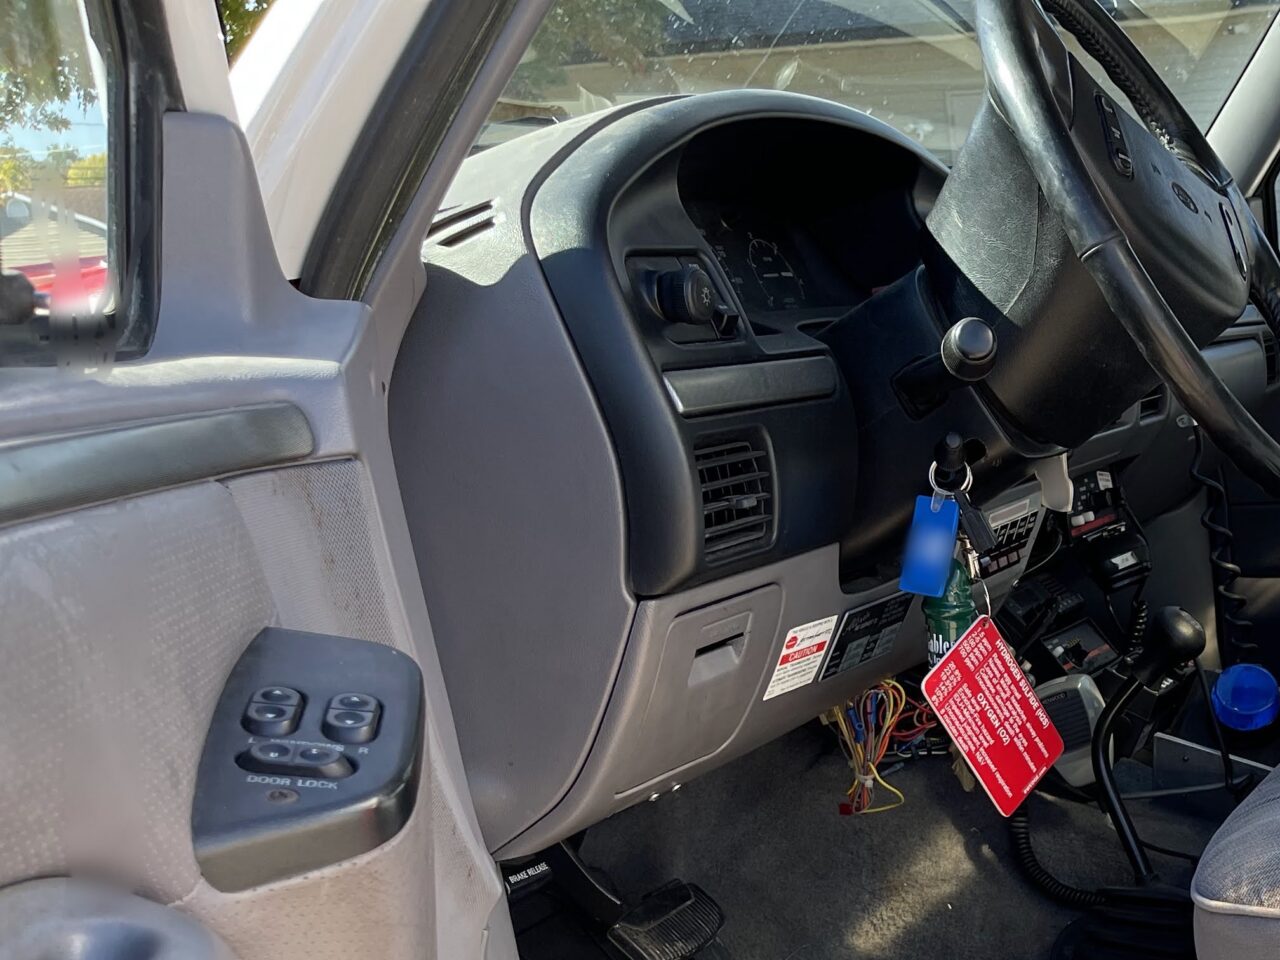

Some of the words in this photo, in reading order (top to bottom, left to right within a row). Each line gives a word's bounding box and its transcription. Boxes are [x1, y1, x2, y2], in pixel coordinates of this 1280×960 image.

[789, 645, 818, 661] CAUTION
[973, 647, 983, 661] ppm
[977, 642, 987, 656] ppm
[964, 657, 974, 671] ppm
[968, 652, 979, 666] ppm
[981, 637, 992, 651] ppm
[1003, 673, 1012, 685] egg
[995, 639, 1021, 680] HYDROGEN
[1019, 679, 1039, 709] SULFIDE
[1035, 708, 1049, 728] (H2S)
[977, 693, 1000, 727] OXYGEN
[996, 726, 1010, 745] (O2)
[358, 747, 369, 755] R
[247, 775, 291, 786] DOOR
[297, 779, 338, 790] LOCK
[509, 871, 528, 883] BRAKE
[527, 862, 548, 876] RELEASE
